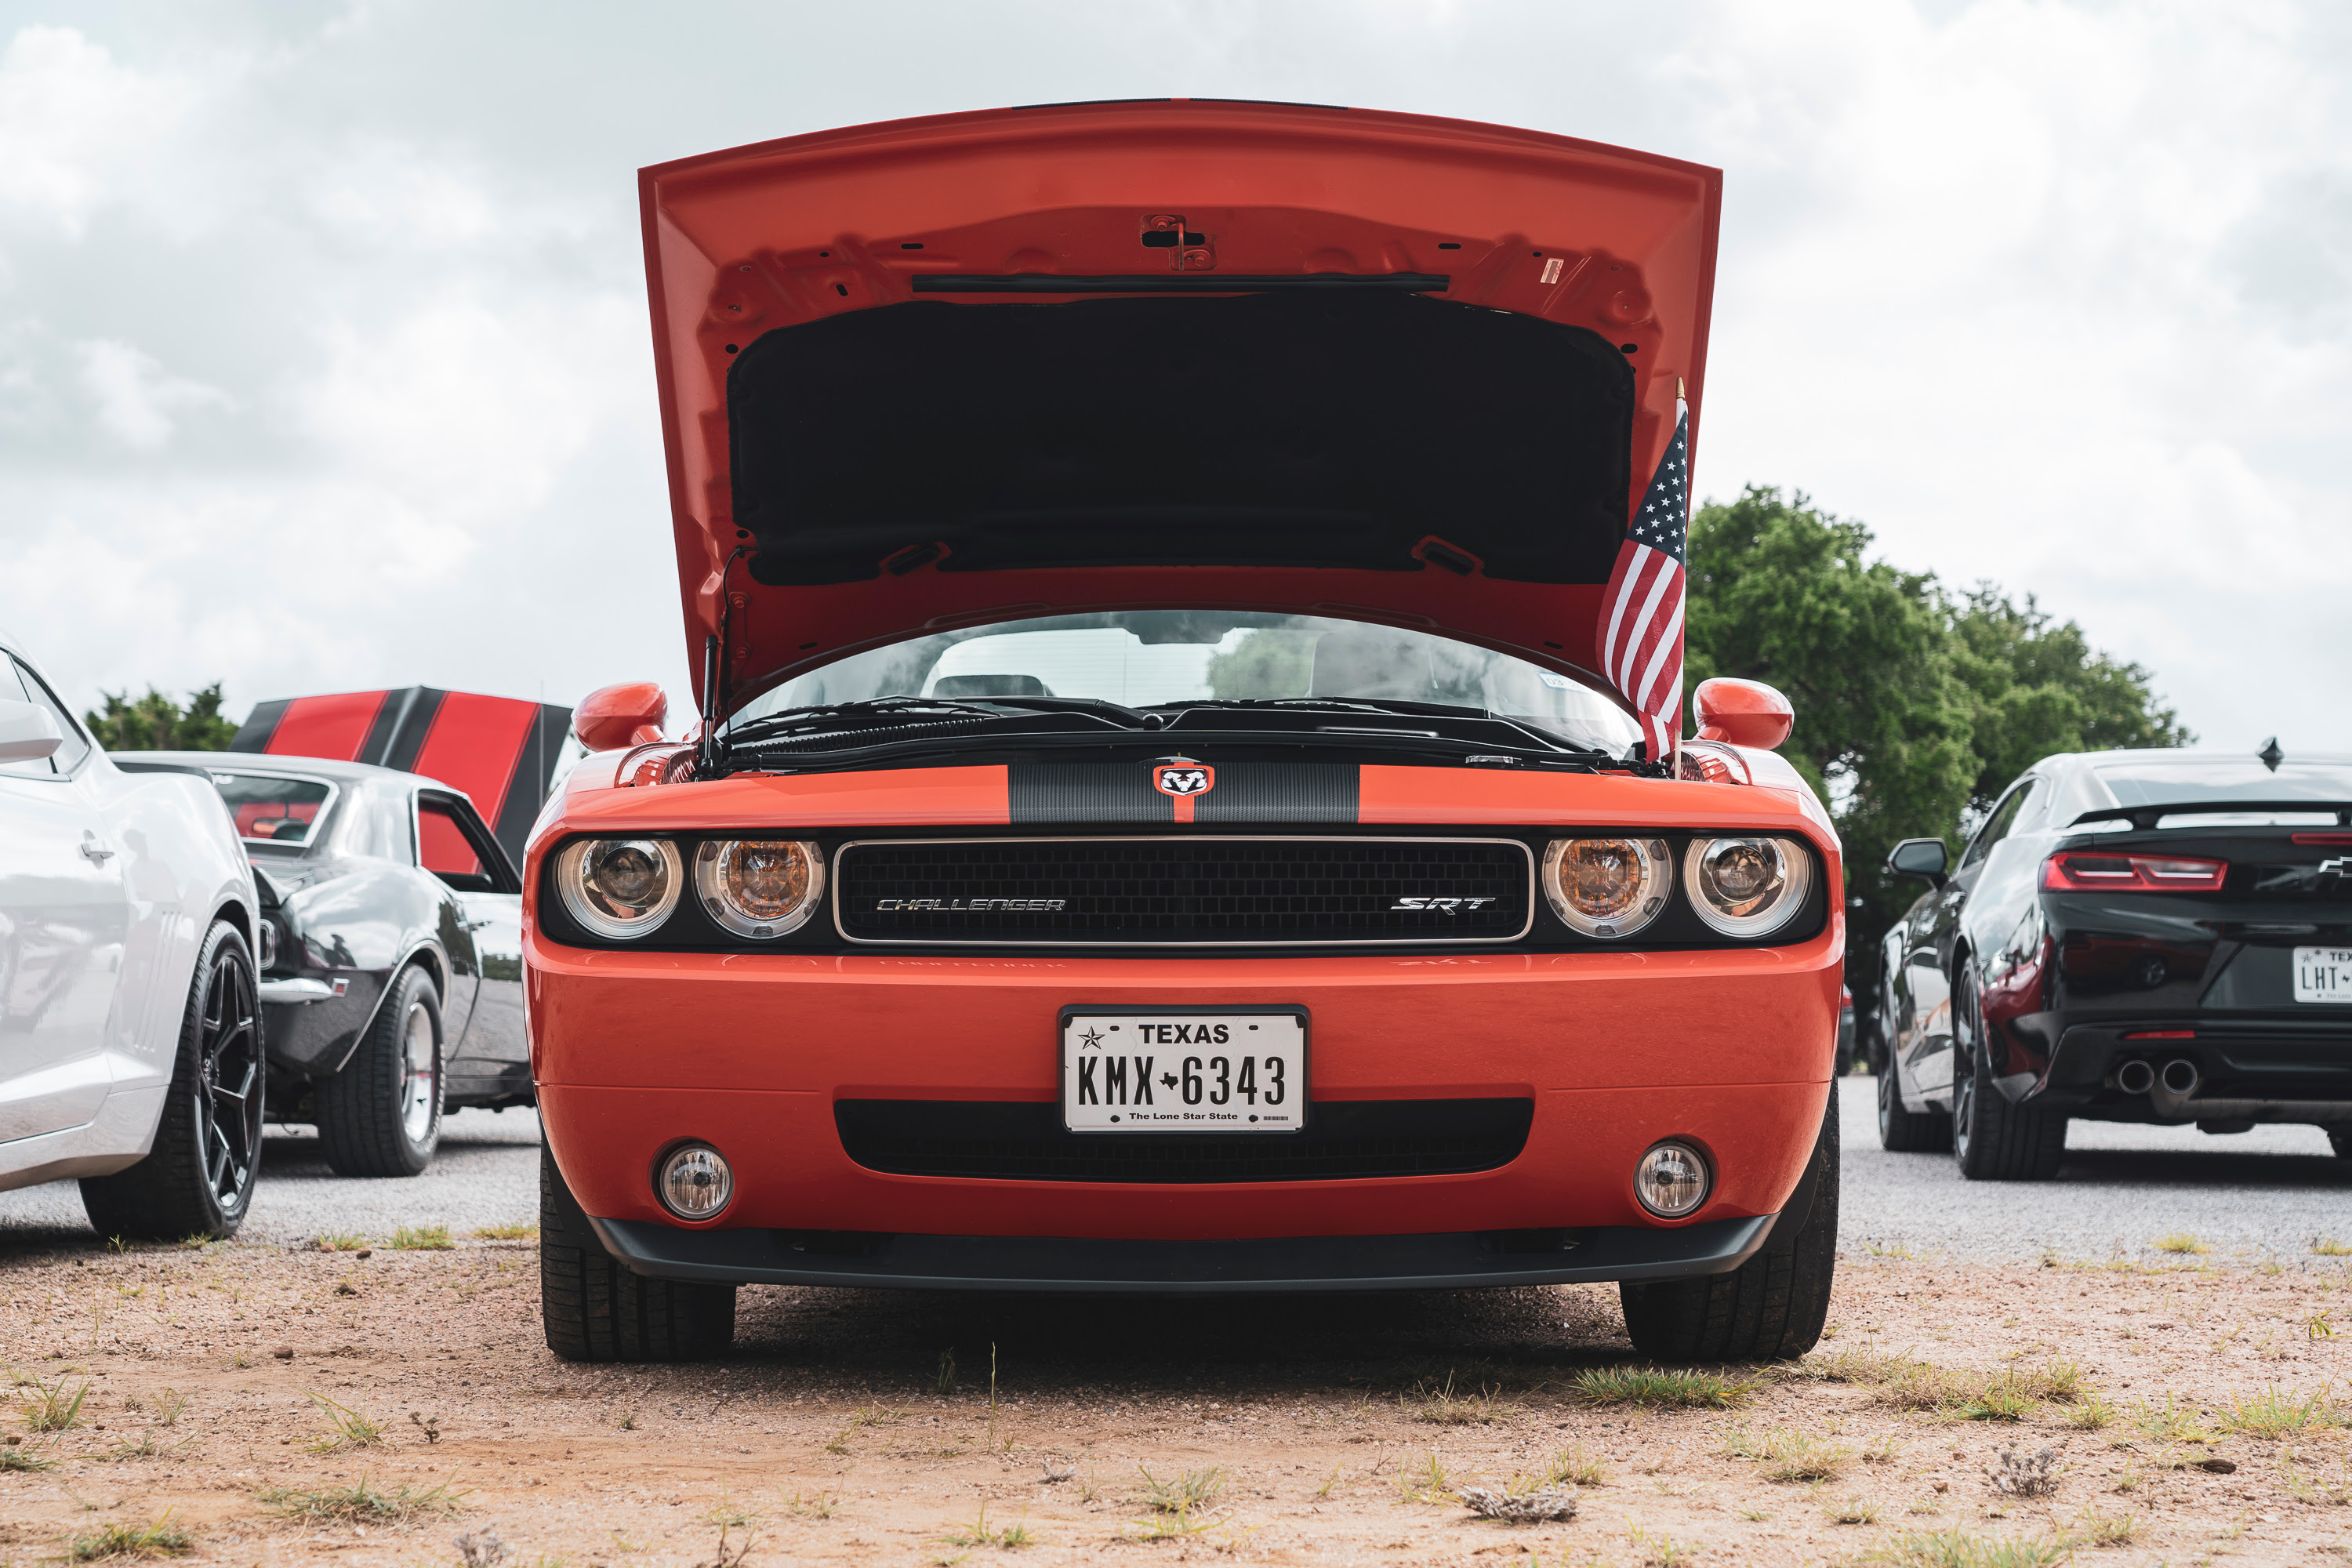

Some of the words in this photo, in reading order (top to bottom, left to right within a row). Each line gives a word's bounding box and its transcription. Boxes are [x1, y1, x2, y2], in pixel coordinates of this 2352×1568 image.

[877, 898, 1066, 911] CHALLENGER
[1390, 897, 1496, 916] SRT
[2302, 967, 2339, 989] LHT
[1138, 1024, 1229, 1044] TEXAS
[1078, 1056, 1154, 1105] KMX
[1181, 1056, 1286, 1105] 6343
